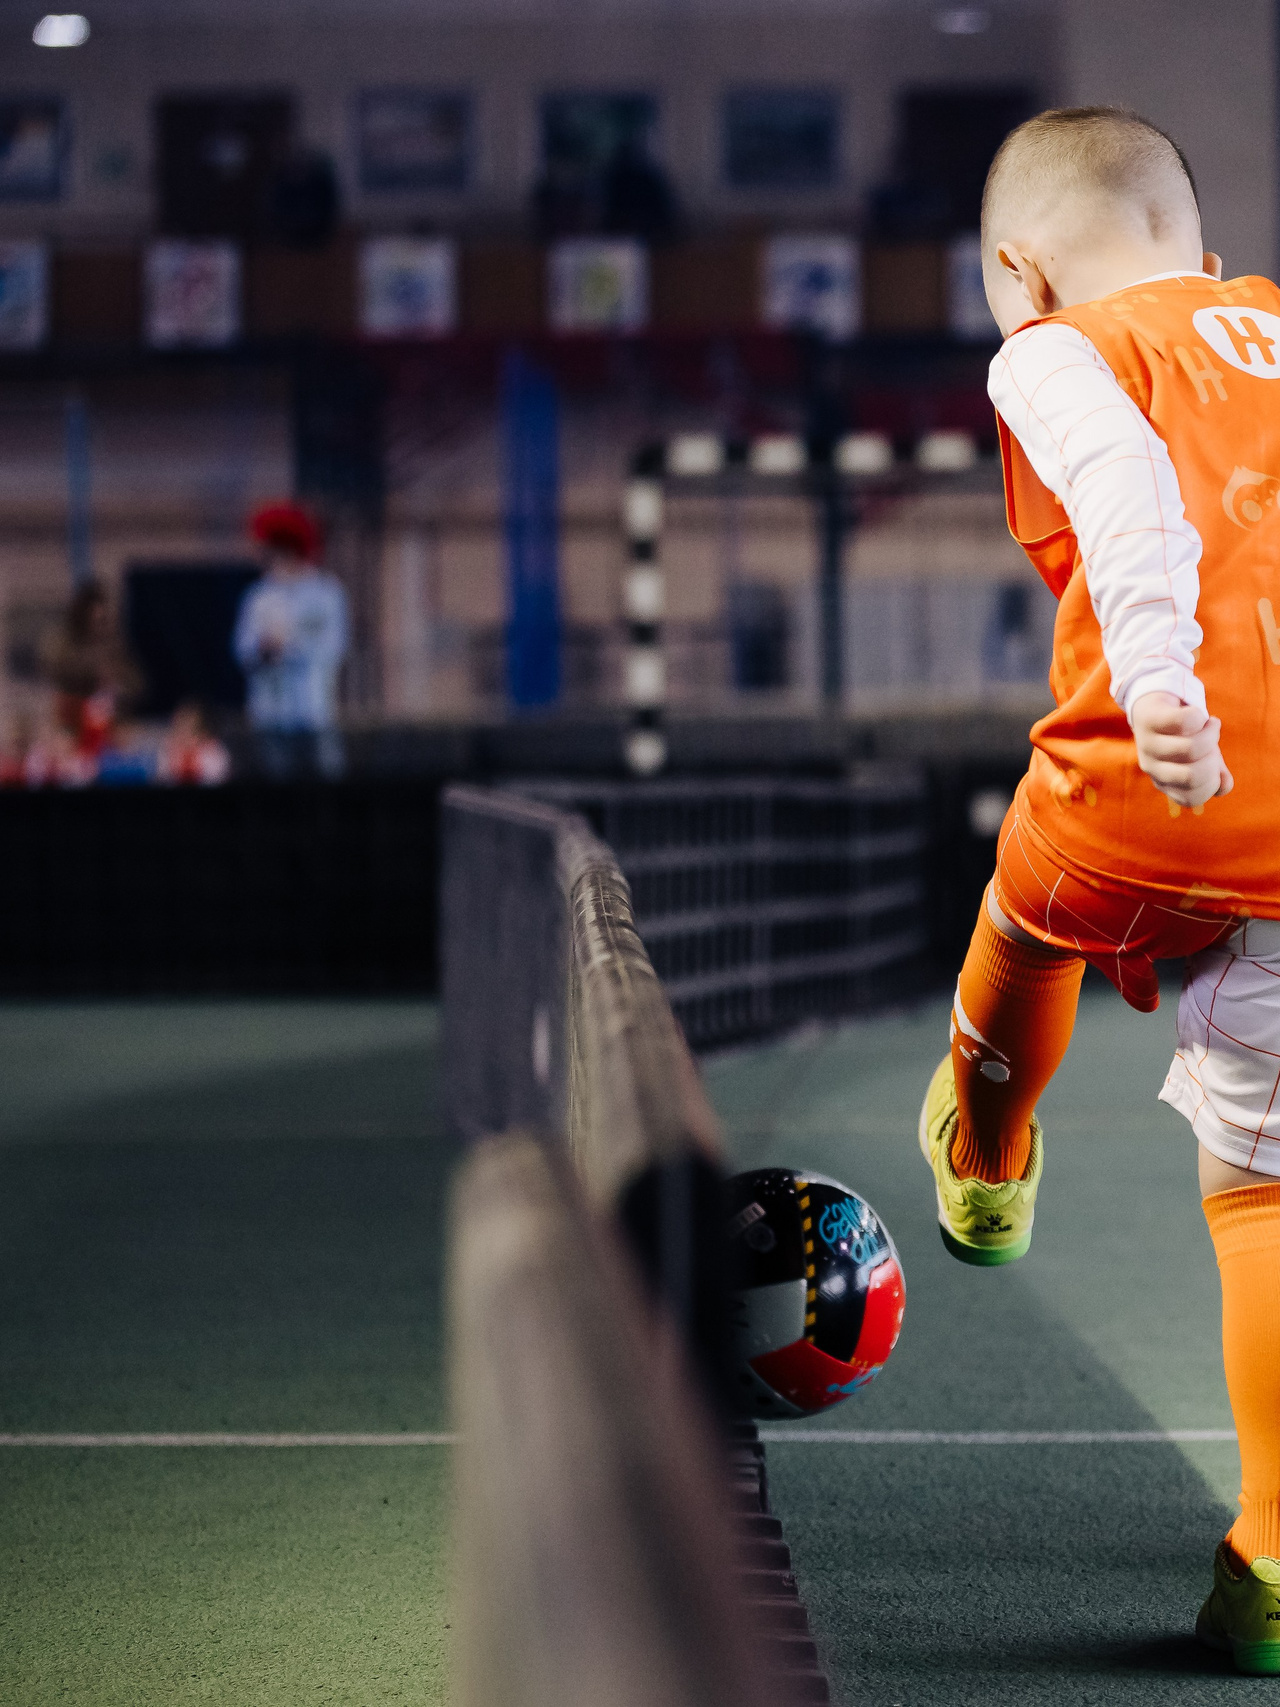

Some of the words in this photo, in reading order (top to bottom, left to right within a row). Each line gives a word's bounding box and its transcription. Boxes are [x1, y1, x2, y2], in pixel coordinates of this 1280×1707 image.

[1214, 314, 1276, 366] H
[1173, 346, 1229, 404] H
[975, 1224, 1013, 1234] KELME
